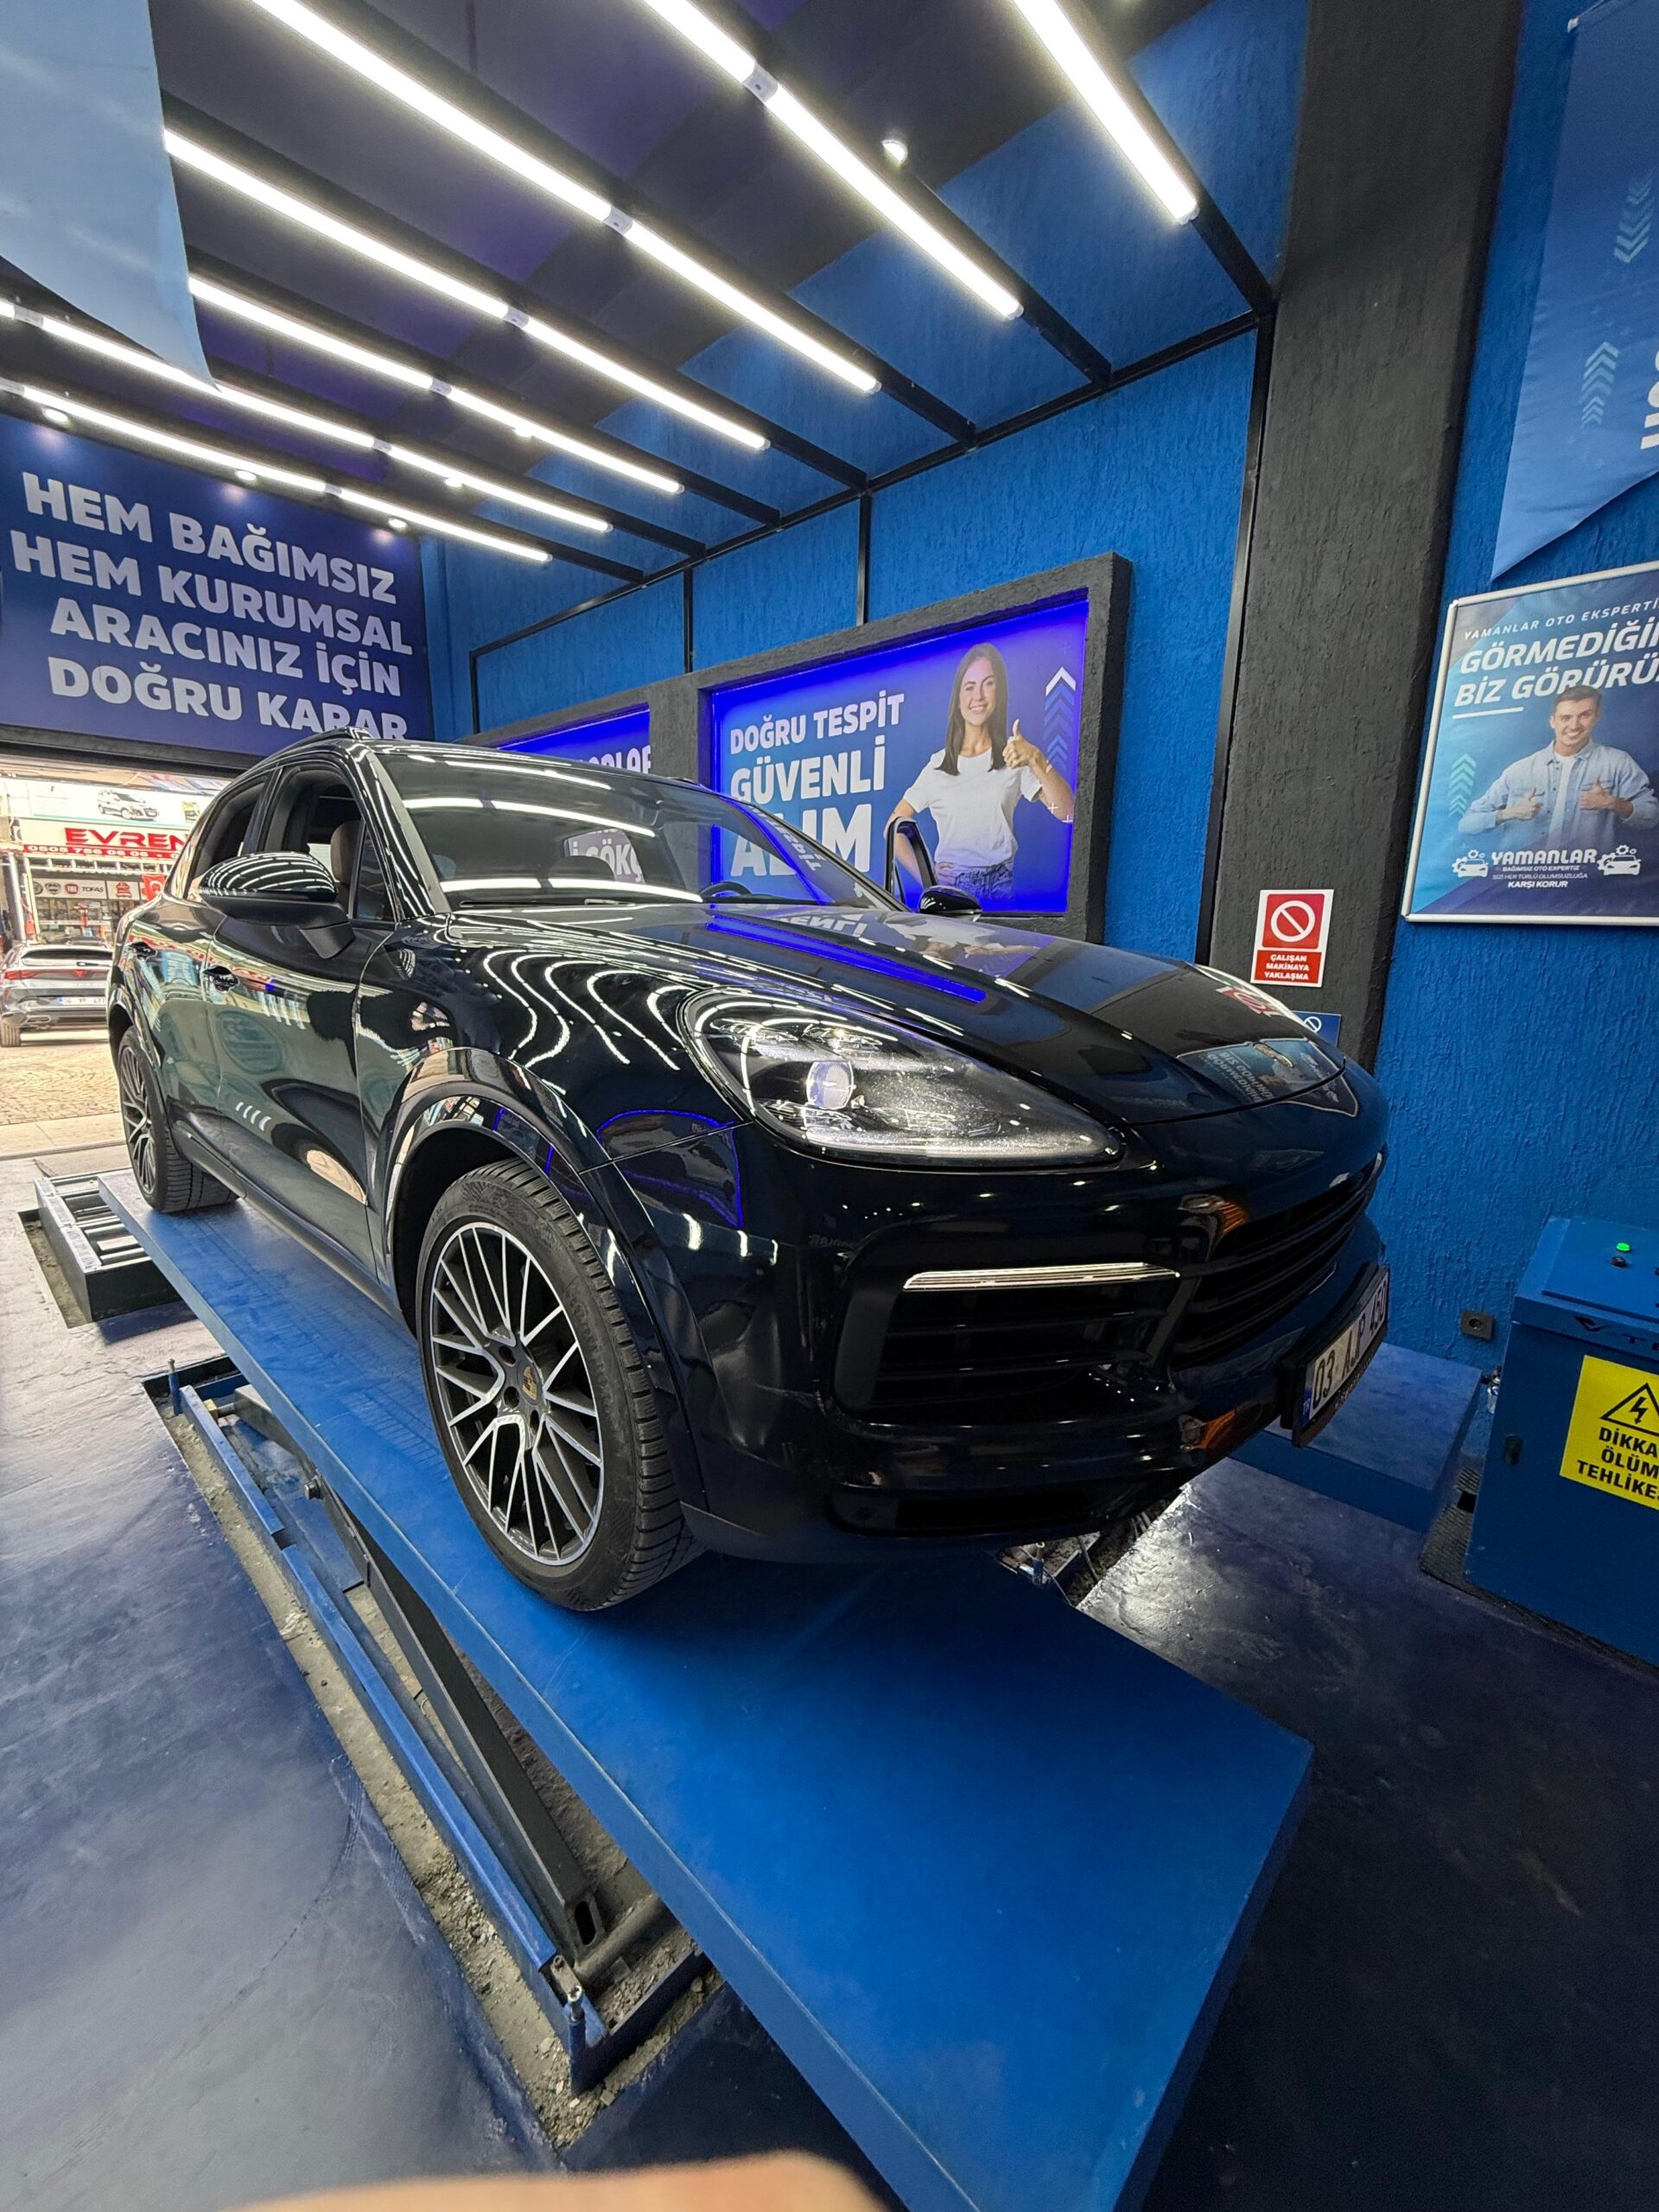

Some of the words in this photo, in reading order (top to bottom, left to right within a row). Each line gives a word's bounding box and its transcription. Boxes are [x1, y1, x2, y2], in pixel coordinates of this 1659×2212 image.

[22, 472, 152, 543] HEM
[169, 512, 397, 604] BAĞIMSIZ
[10, 530, 142, 597] HEM
[158, 565, 412, 655] KURUMSAL
[1464, 620, 1540, 640] YAMANLAR
[1546, 613, 1575, 627] OTO
[1581, 597, 1659, 621] EKSPERTİ
[50, 597, 303, 678] ARACINIZ
[315, 641, 401, 696] İÇİN
[48, 656, 243, 721] DOĞRU
[1454, 676, 1507, 707] BİZ
[1511, 652, 1659, 700] GÖRÜRÜ
[730, 715, 806, 754] DOĞRU
[814, 690, 905, 739] TESPİT
[730, 734, 885, 805] GÜVENLİ
[1491, 849, 1597, 866] YAMANLAR
[1508, 880, 1535, 889] KARŞI
[1263, 971, 1309, 981] YAKLAŞMA
[1266, 963, 1310, 972] MAKİNAYA
[1270, 954, 1307, 963] ÇALIŞAN
[1312, 1350, 1335, 1410] 03
[1599, 1427, 1657, 1459] DİKKA
[1601, 1445, 1659, 1479] ÖLÜM
[1577, 1459, 1659, 1502] TEHLİKE
